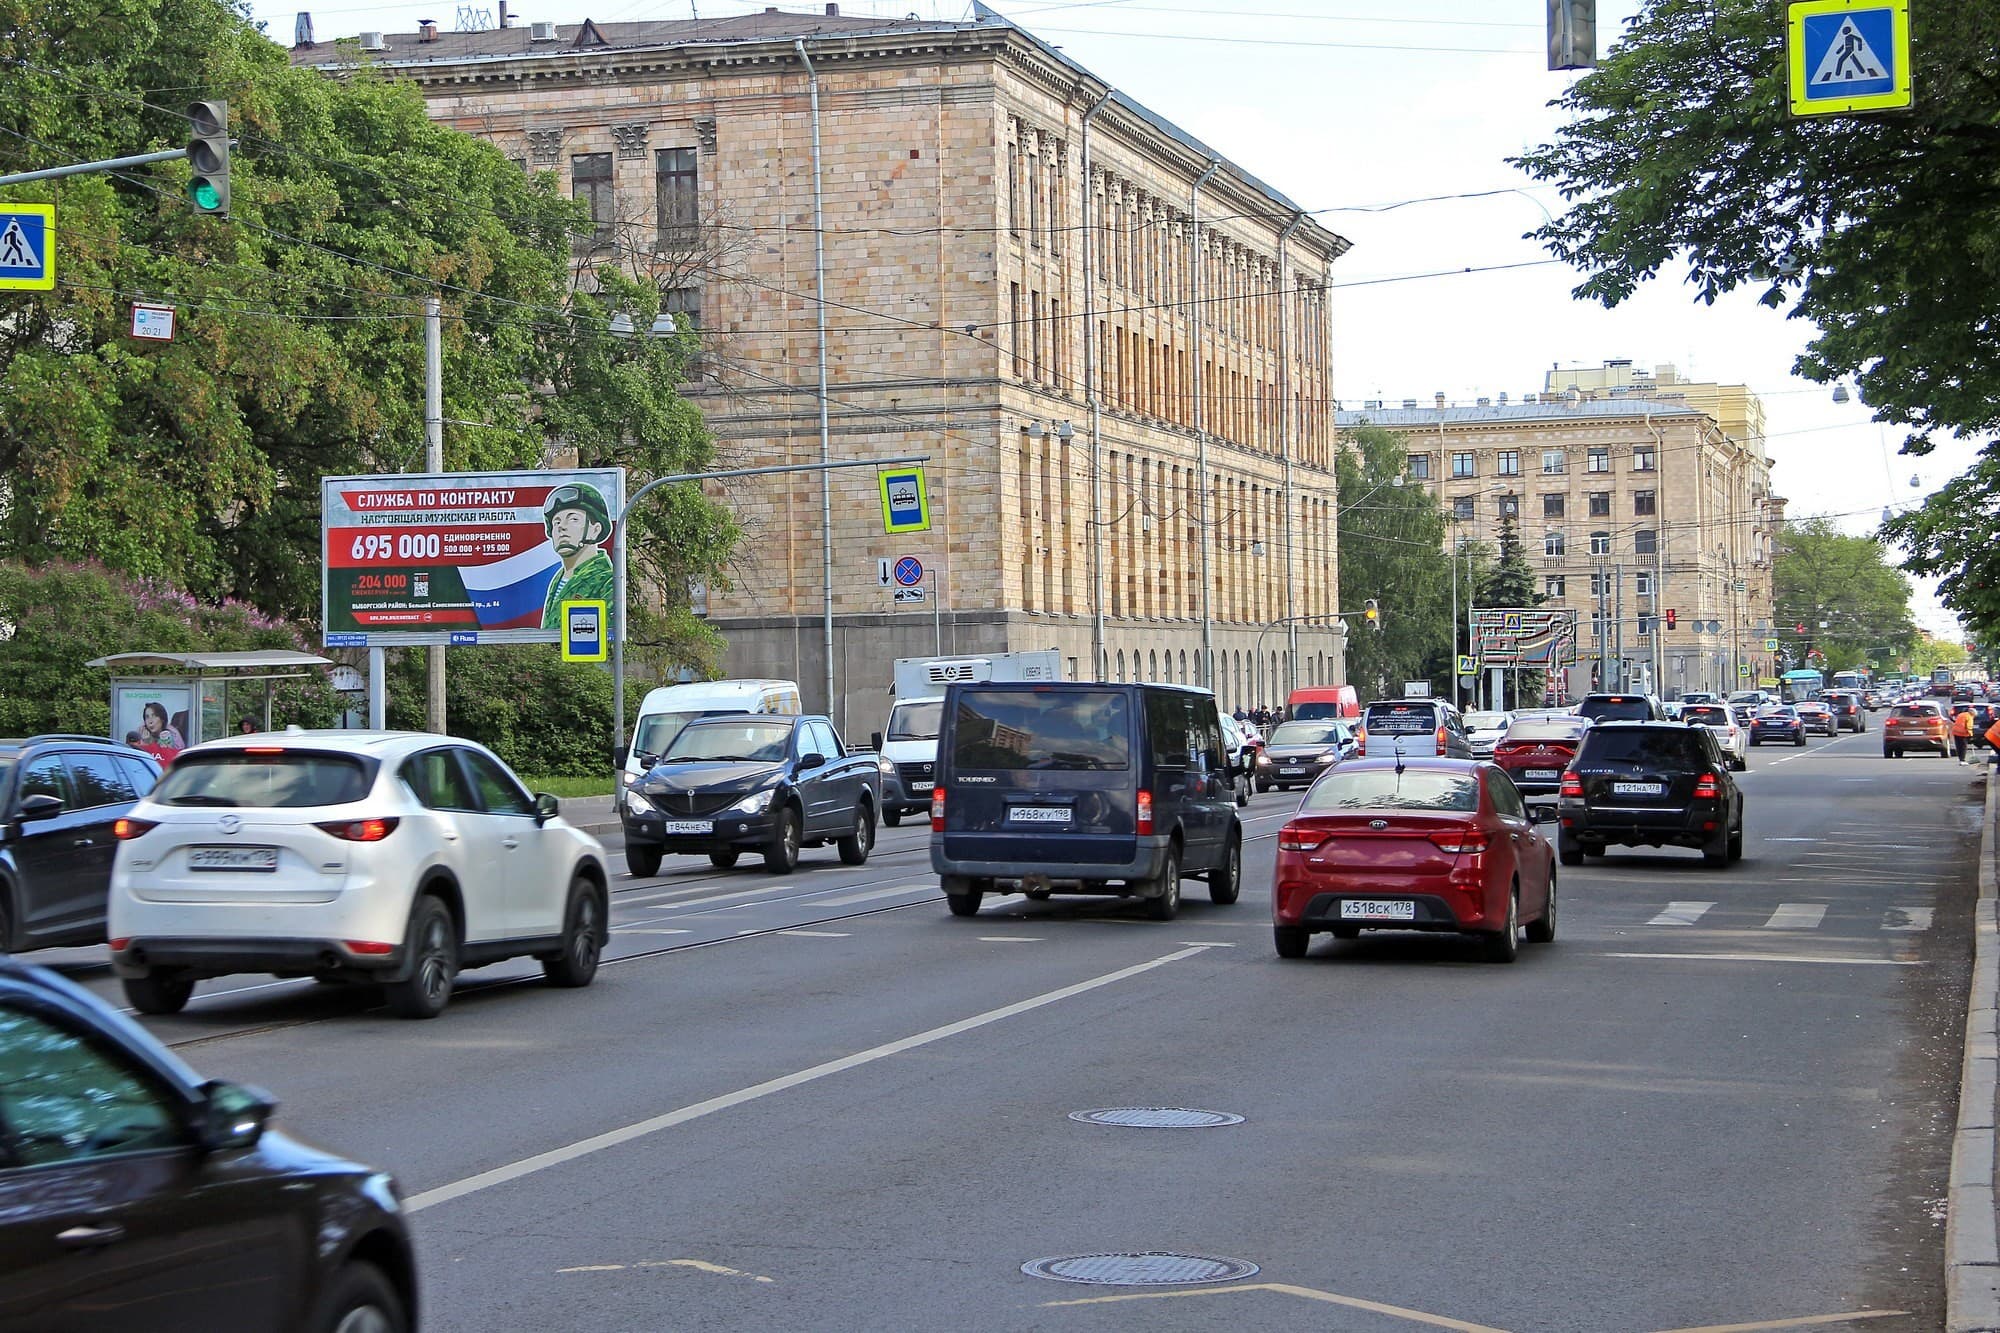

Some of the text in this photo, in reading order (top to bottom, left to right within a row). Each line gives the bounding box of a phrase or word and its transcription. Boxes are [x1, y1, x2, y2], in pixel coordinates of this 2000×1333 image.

[142, 326, 161, 336] 20 21
[358, 490, 515, 508] СЛУЖБА ПО КОНТРАКТУ
[361, 511, 516, 524] НАСТОЯЩАЯ МУЖСКАЯ РАБОТА
[443, 532, 511, 542] ЕДИНОВРЕМЕННО
[351, 533, 440, 560] 695 000
[443, 545, 458, 553] 500
[459, 545, 473, 553] 000
[482, 544, 495, 552] 195
[497, 543, 510, 551] 000
[358, 575, 381, 589] 204
[384, 574, 407, 588] 000
[351, 601, 387, 610] ВЫБОРГСКИЙ
[387, 601, 408, 609] РАЙОН:
[1013, 809, 1070, 819] М968КУ 198
[669, 823, 701, 831] Т844НЕ
[1344, 901, 1410, 914] Х518СК 178
